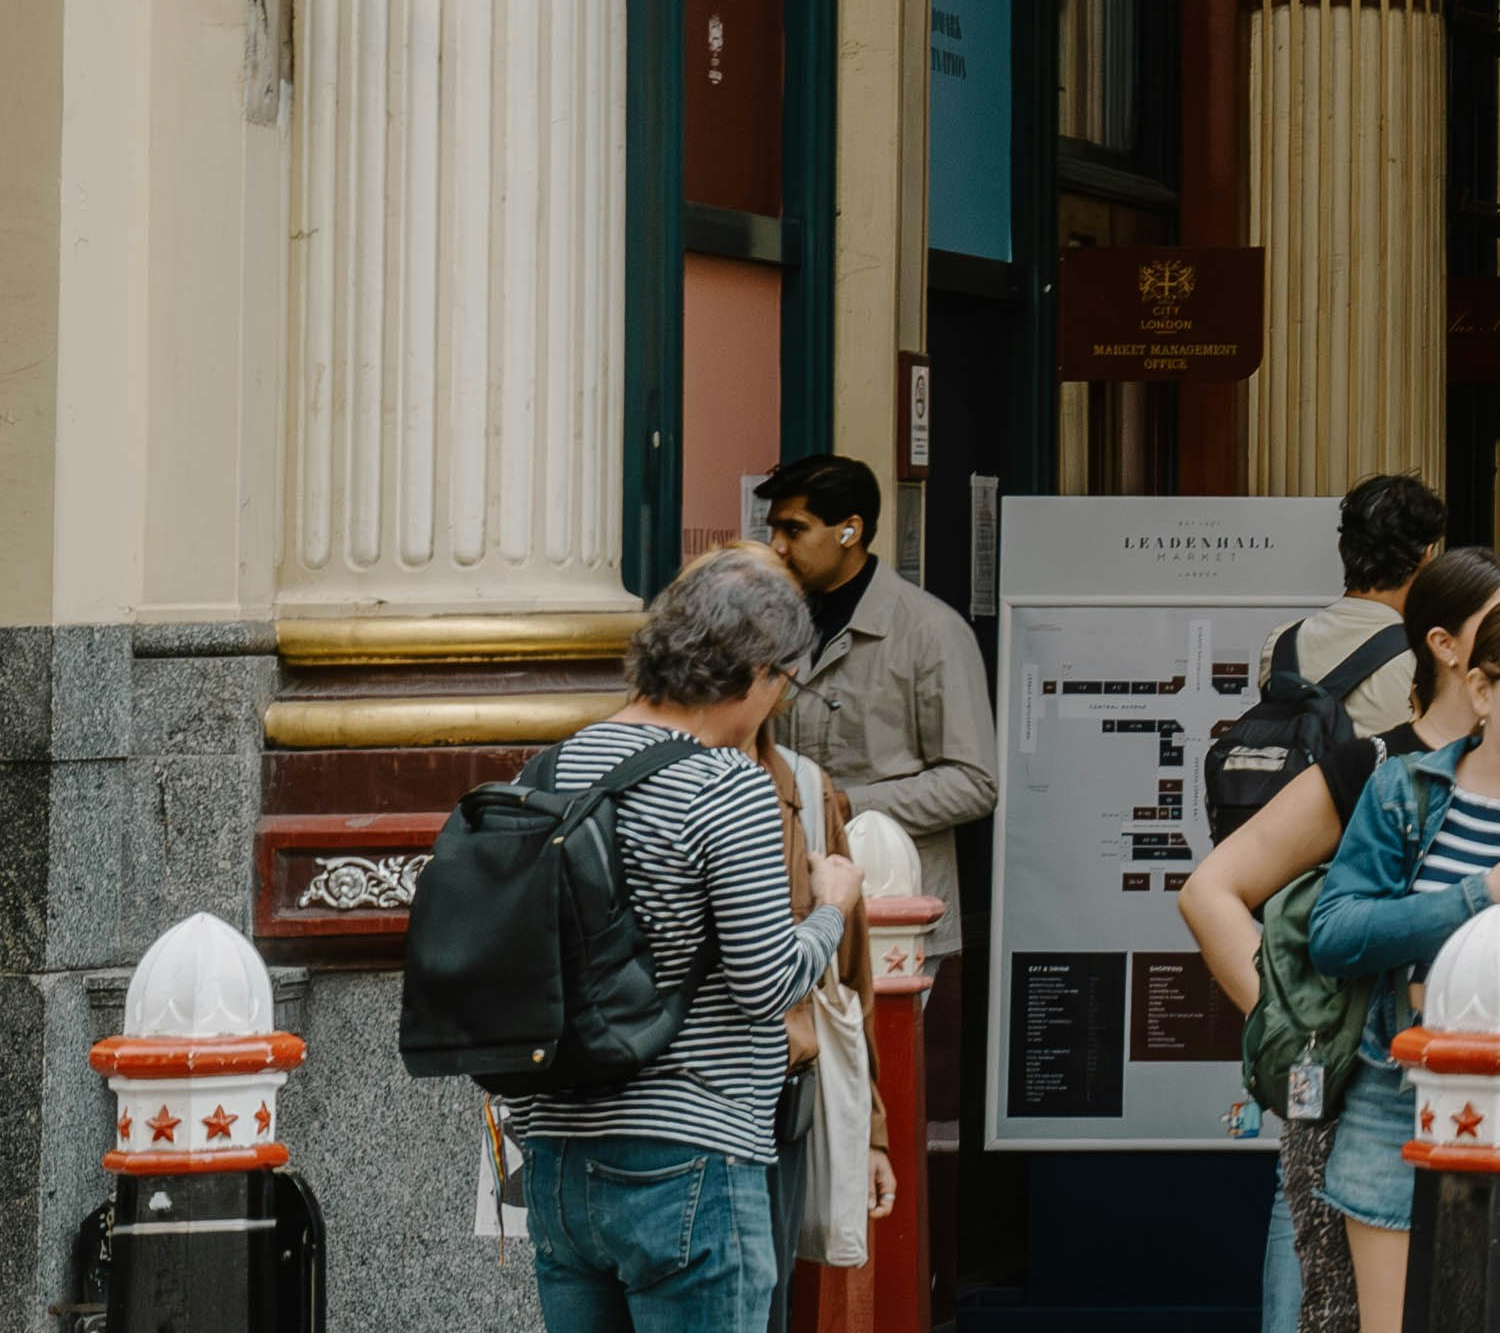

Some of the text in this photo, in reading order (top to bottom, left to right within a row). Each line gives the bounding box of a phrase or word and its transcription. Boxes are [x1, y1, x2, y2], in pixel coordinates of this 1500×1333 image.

[1152, 306, 1180, 317] CITY
[1140, 319, 1193, 331] LONDON
[1092, 343, 1239, 357] MARKET MANAGEMENT
[1143, 358, 1188, 371] OFFICE
[684, 528, 737, 555] WELCO
[1123, 536, 1275, 550] LEADENHALL
[1156, 552, 1238, 562] MARKET
